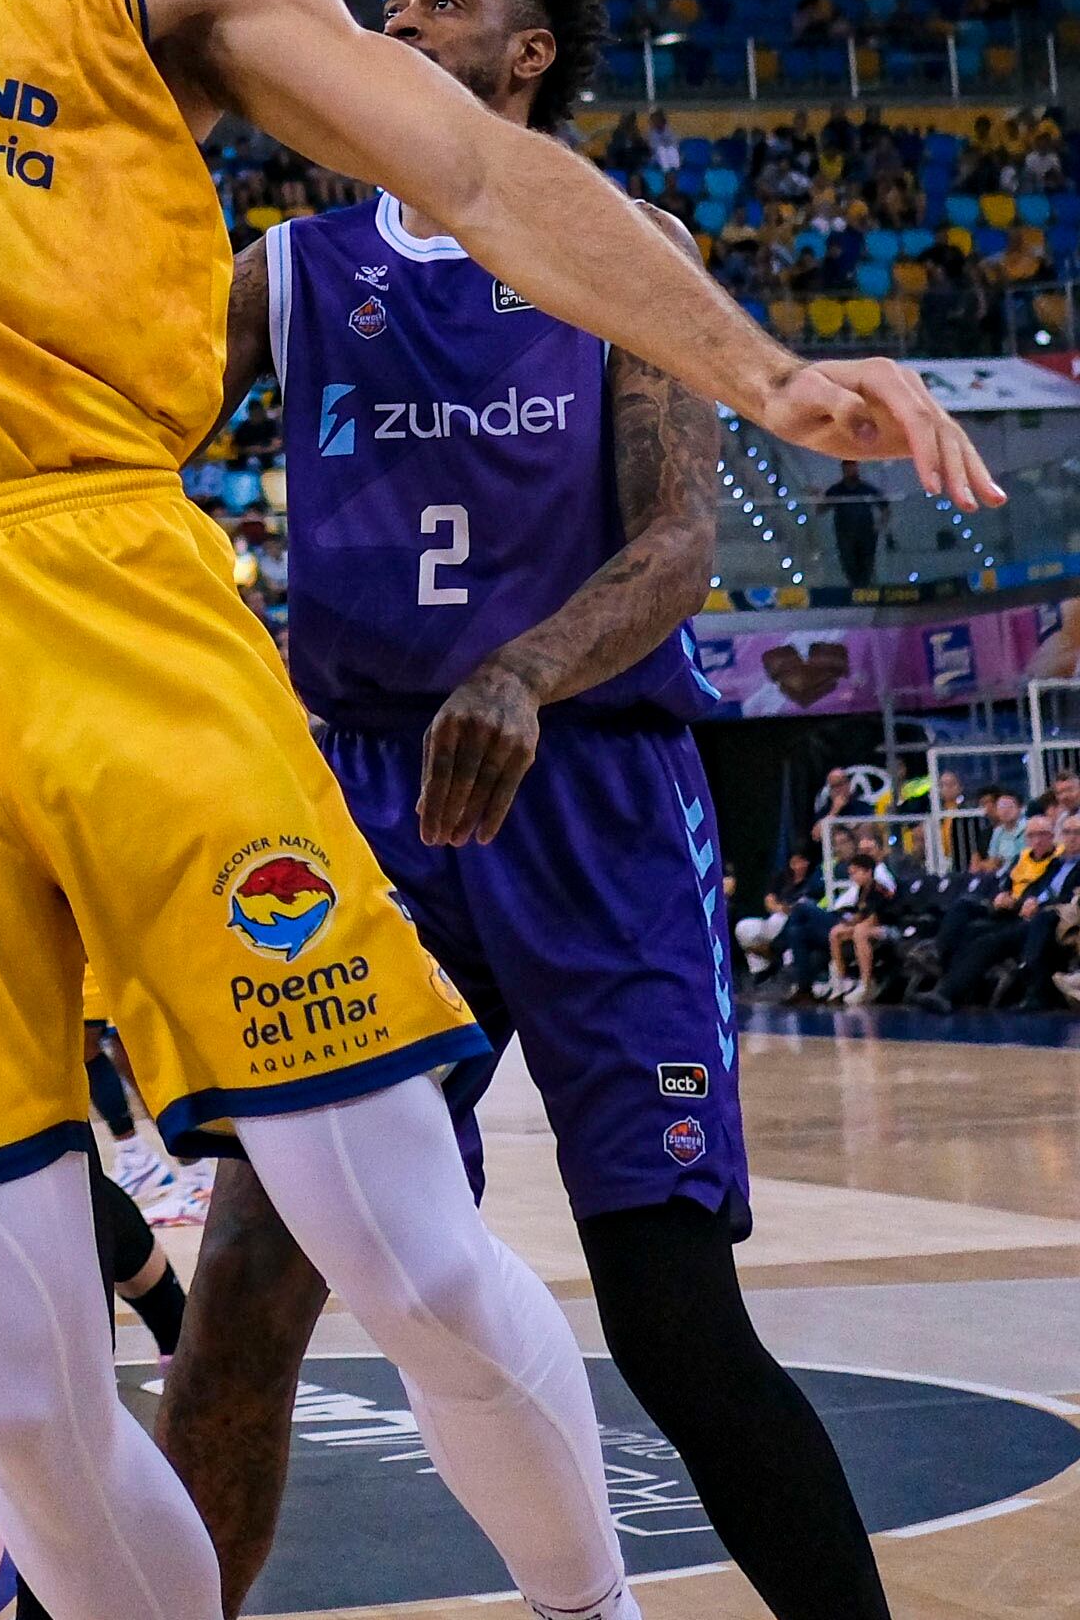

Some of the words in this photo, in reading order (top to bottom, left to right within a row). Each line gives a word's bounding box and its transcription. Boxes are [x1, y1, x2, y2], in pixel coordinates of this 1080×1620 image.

[374, 387, 575, 439] zunder
[418, 504, 470, 606] 2
[212, 835, 271, 897] DISCOVER
[231, 956, 369, 1012] Poema
[243, 1011, 293, 1049] del
[304, 993, 377, 1034] Mar
[250, 1026, 389, 1074] AQUARIUM
[665, 1076, 697, 1092] acb
